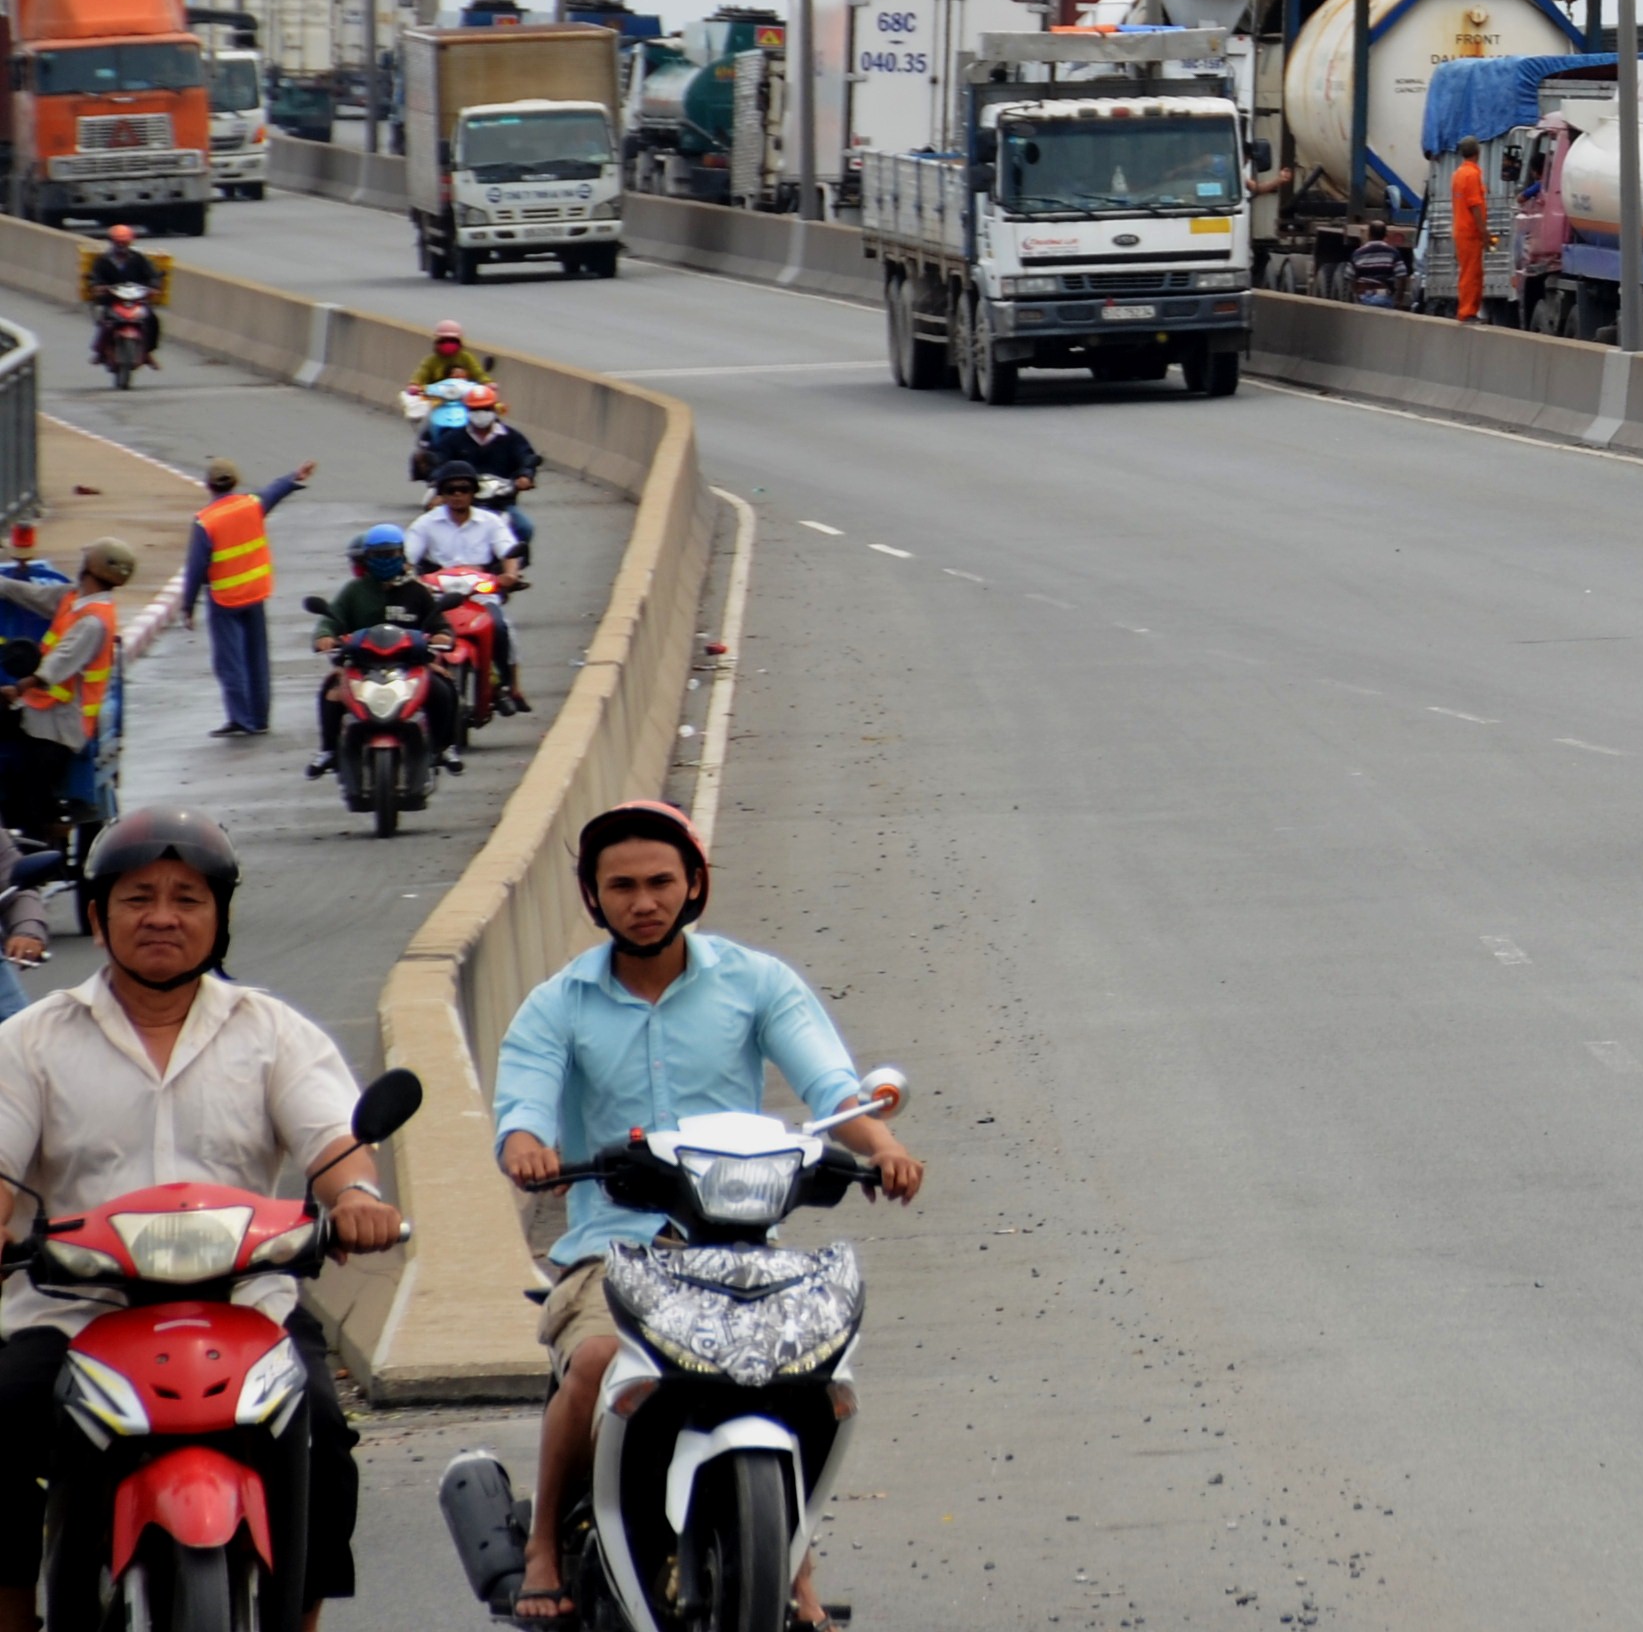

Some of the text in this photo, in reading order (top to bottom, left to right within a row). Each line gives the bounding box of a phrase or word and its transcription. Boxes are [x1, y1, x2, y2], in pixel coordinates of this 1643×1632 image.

[877, 12, 916, 33] 68C
[1455, 34, 1500, 45] FRONT
[861, 51, 927, 73] 040.35
